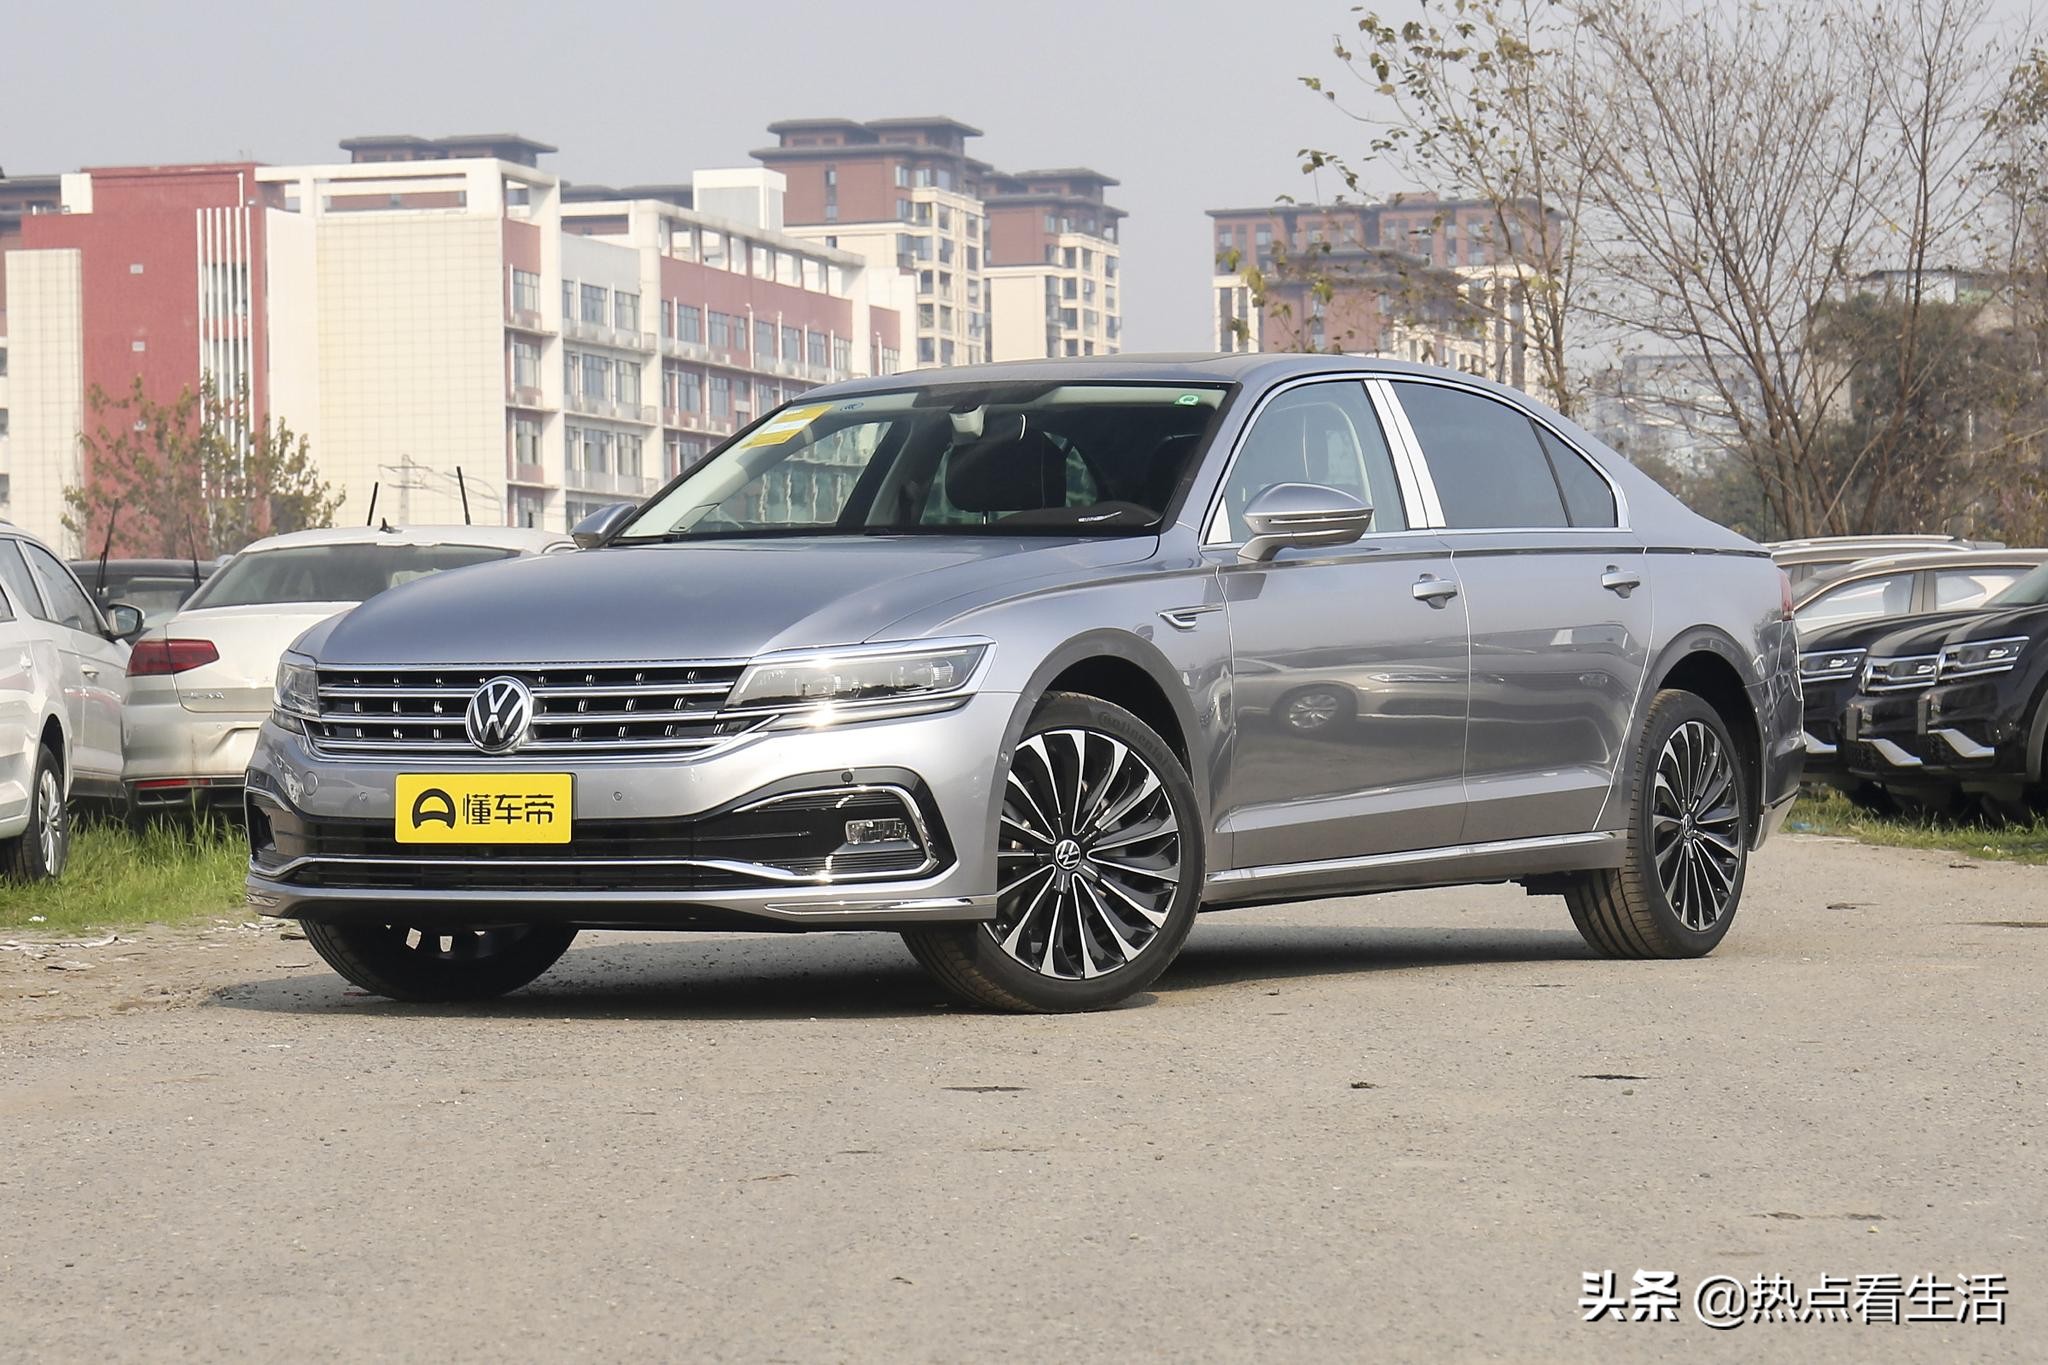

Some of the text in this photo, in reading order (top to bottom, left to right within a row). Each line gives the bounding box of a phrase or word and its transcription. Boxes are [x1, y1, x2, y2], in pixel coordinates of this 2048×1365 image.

[470, 681, 527, 746] VW
[462, 793, 555, 825] 懂车帝
